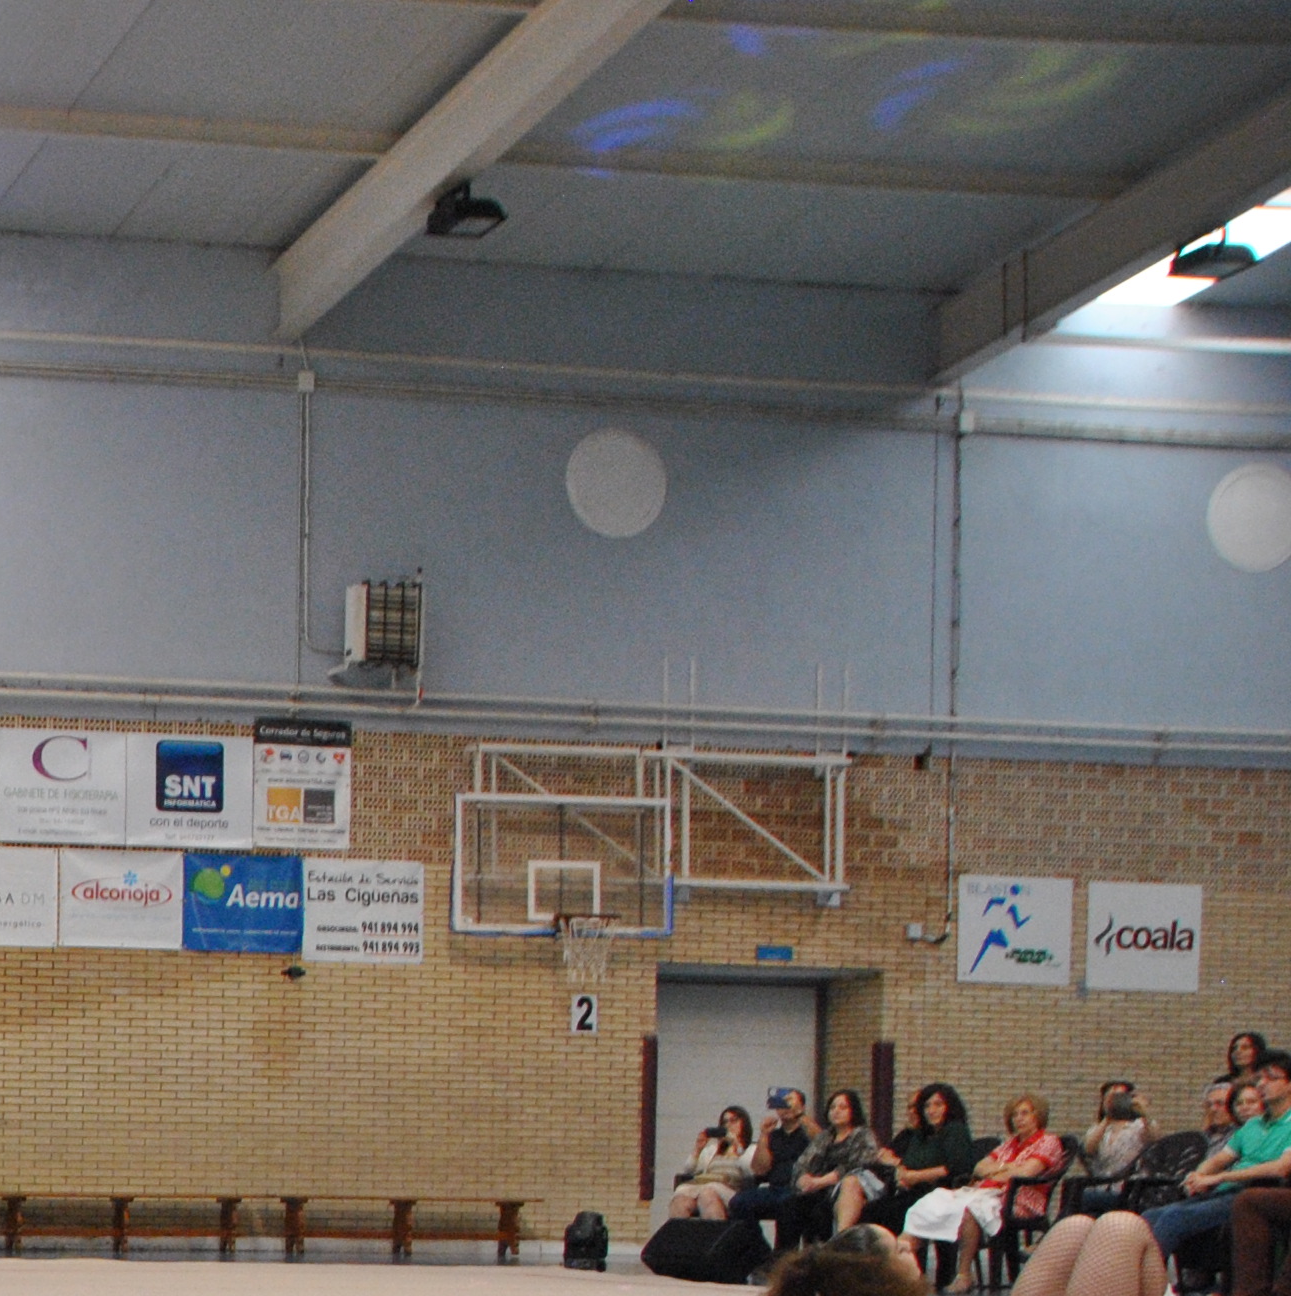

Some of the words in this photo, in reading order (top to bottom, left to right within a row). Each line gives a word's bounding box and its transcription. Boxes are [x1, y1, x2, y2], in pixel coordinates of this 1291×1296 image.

[164, 774, 216, 799] SNT
[268, 805, 300, 821] TGA
[149, 817, 170, 827] con
[173, 817, 183, 827] el
[186, 818, 229, 830] deporte
[226, 883, 299, 909] Aema
[307, 887, 336, 902] Las
[361, 921, 378, 934] 941
[380, 921, 398, 934] 894
[1115, 919, 1195, 951] coala
[362, 940, 379, 953] 941
[576, 995, 593, 1031] 2
